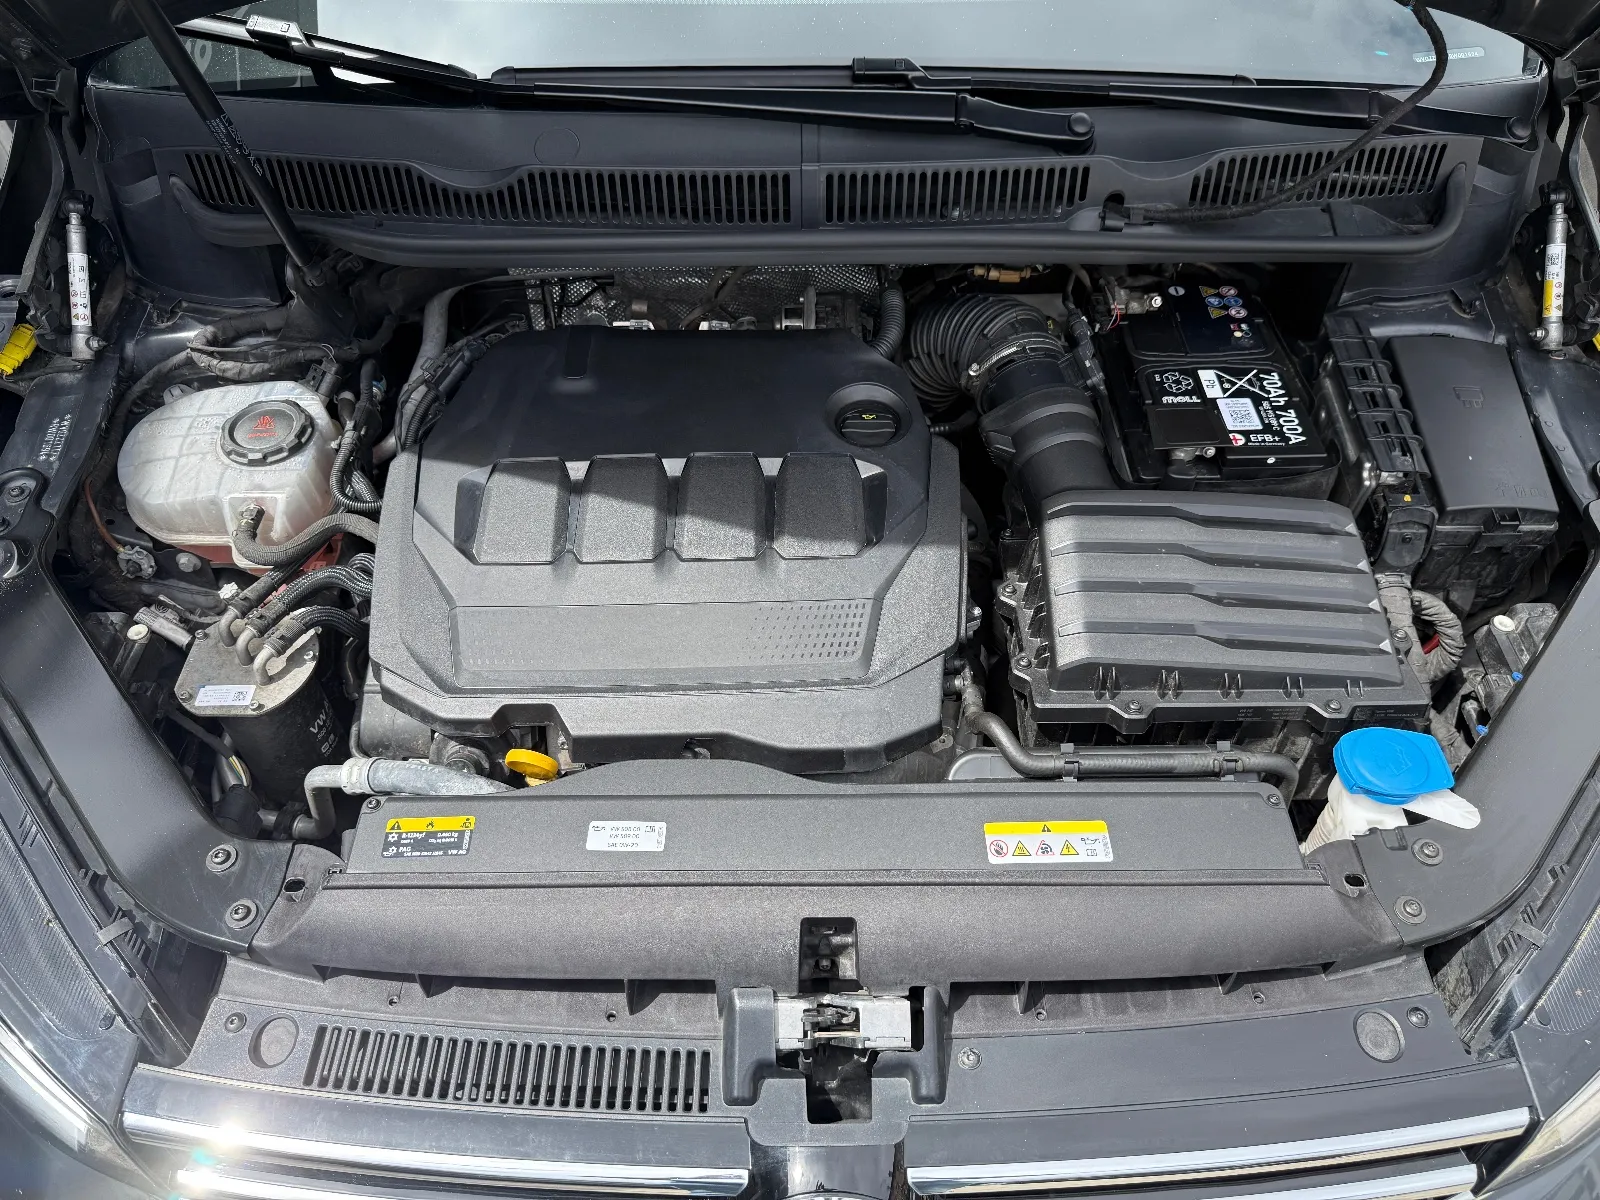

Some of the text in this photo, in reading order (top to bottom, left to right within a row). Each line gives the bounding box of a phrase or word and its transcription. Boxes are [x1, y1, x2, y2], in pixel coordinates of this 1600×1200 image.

[1203, 379, 1215, 389] Pb
[1259, 373, 1307, 445] 70Ah 700A
[1249, 433, 1281, 442] EFB+
[309, 711, 327, 734] VW
